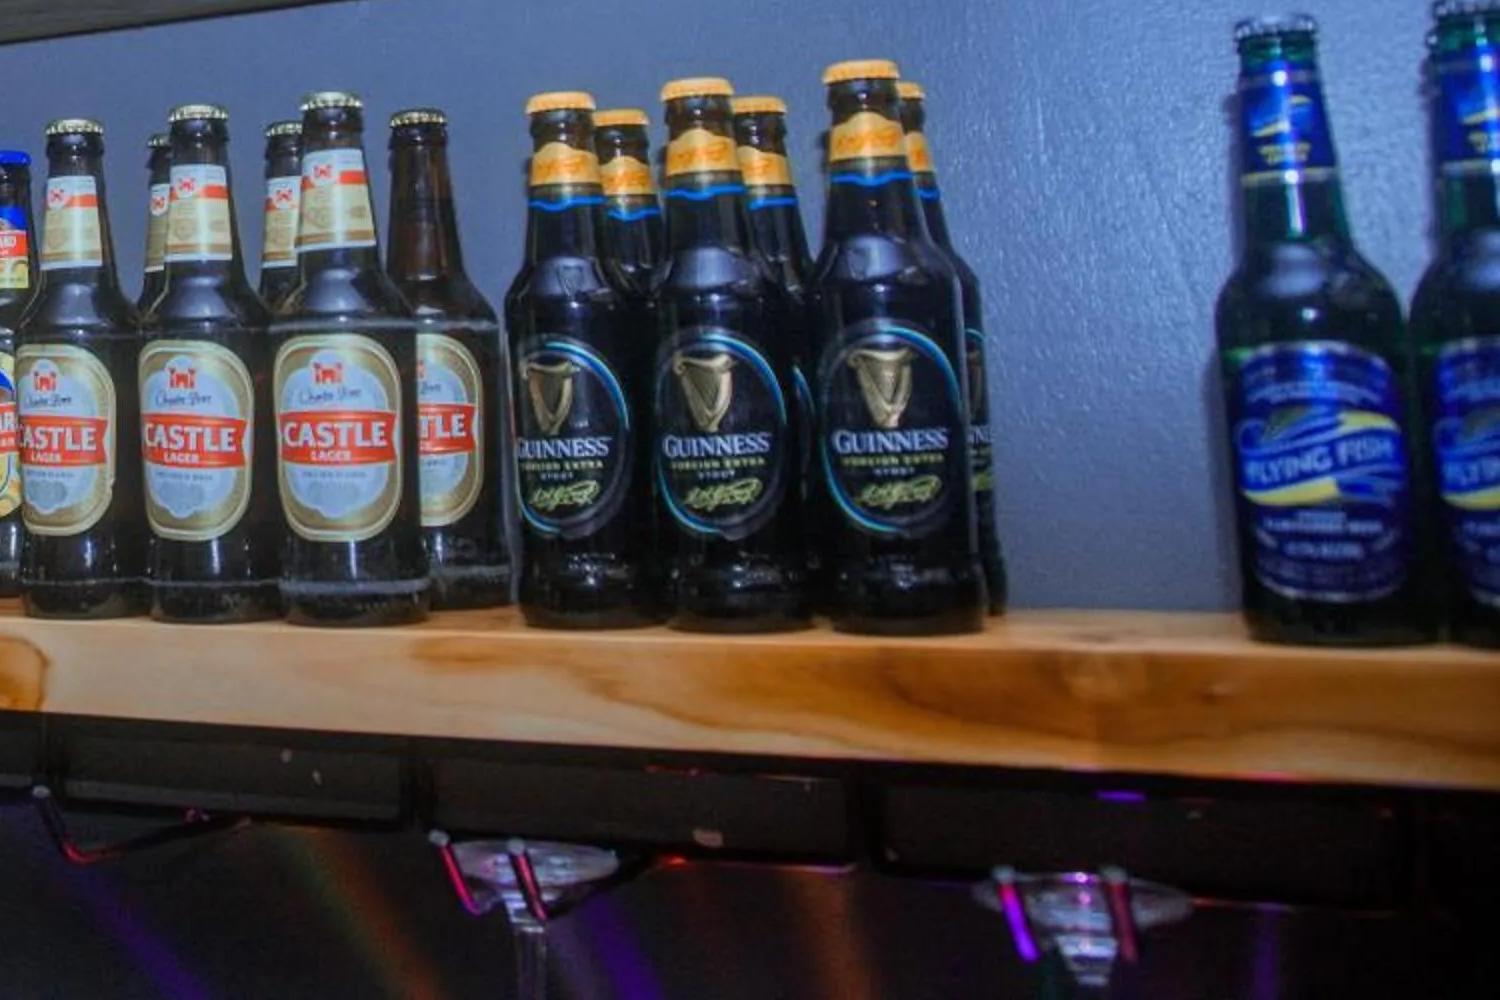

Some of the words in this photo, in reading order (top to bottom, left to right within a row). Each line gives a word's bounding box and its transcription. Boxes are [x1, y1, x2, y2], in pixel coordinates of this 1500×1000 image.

[144, 423, 237, 453] CASTLE
[283, 420, 389, 449] CASTLE
[517, 436, 612, 459] GUINNESS
[662, 432, 772, 458] GUINNESS
[833, 427, 950, 453] GUINNESS
[1244, 446, 1334, 484] FLYING
